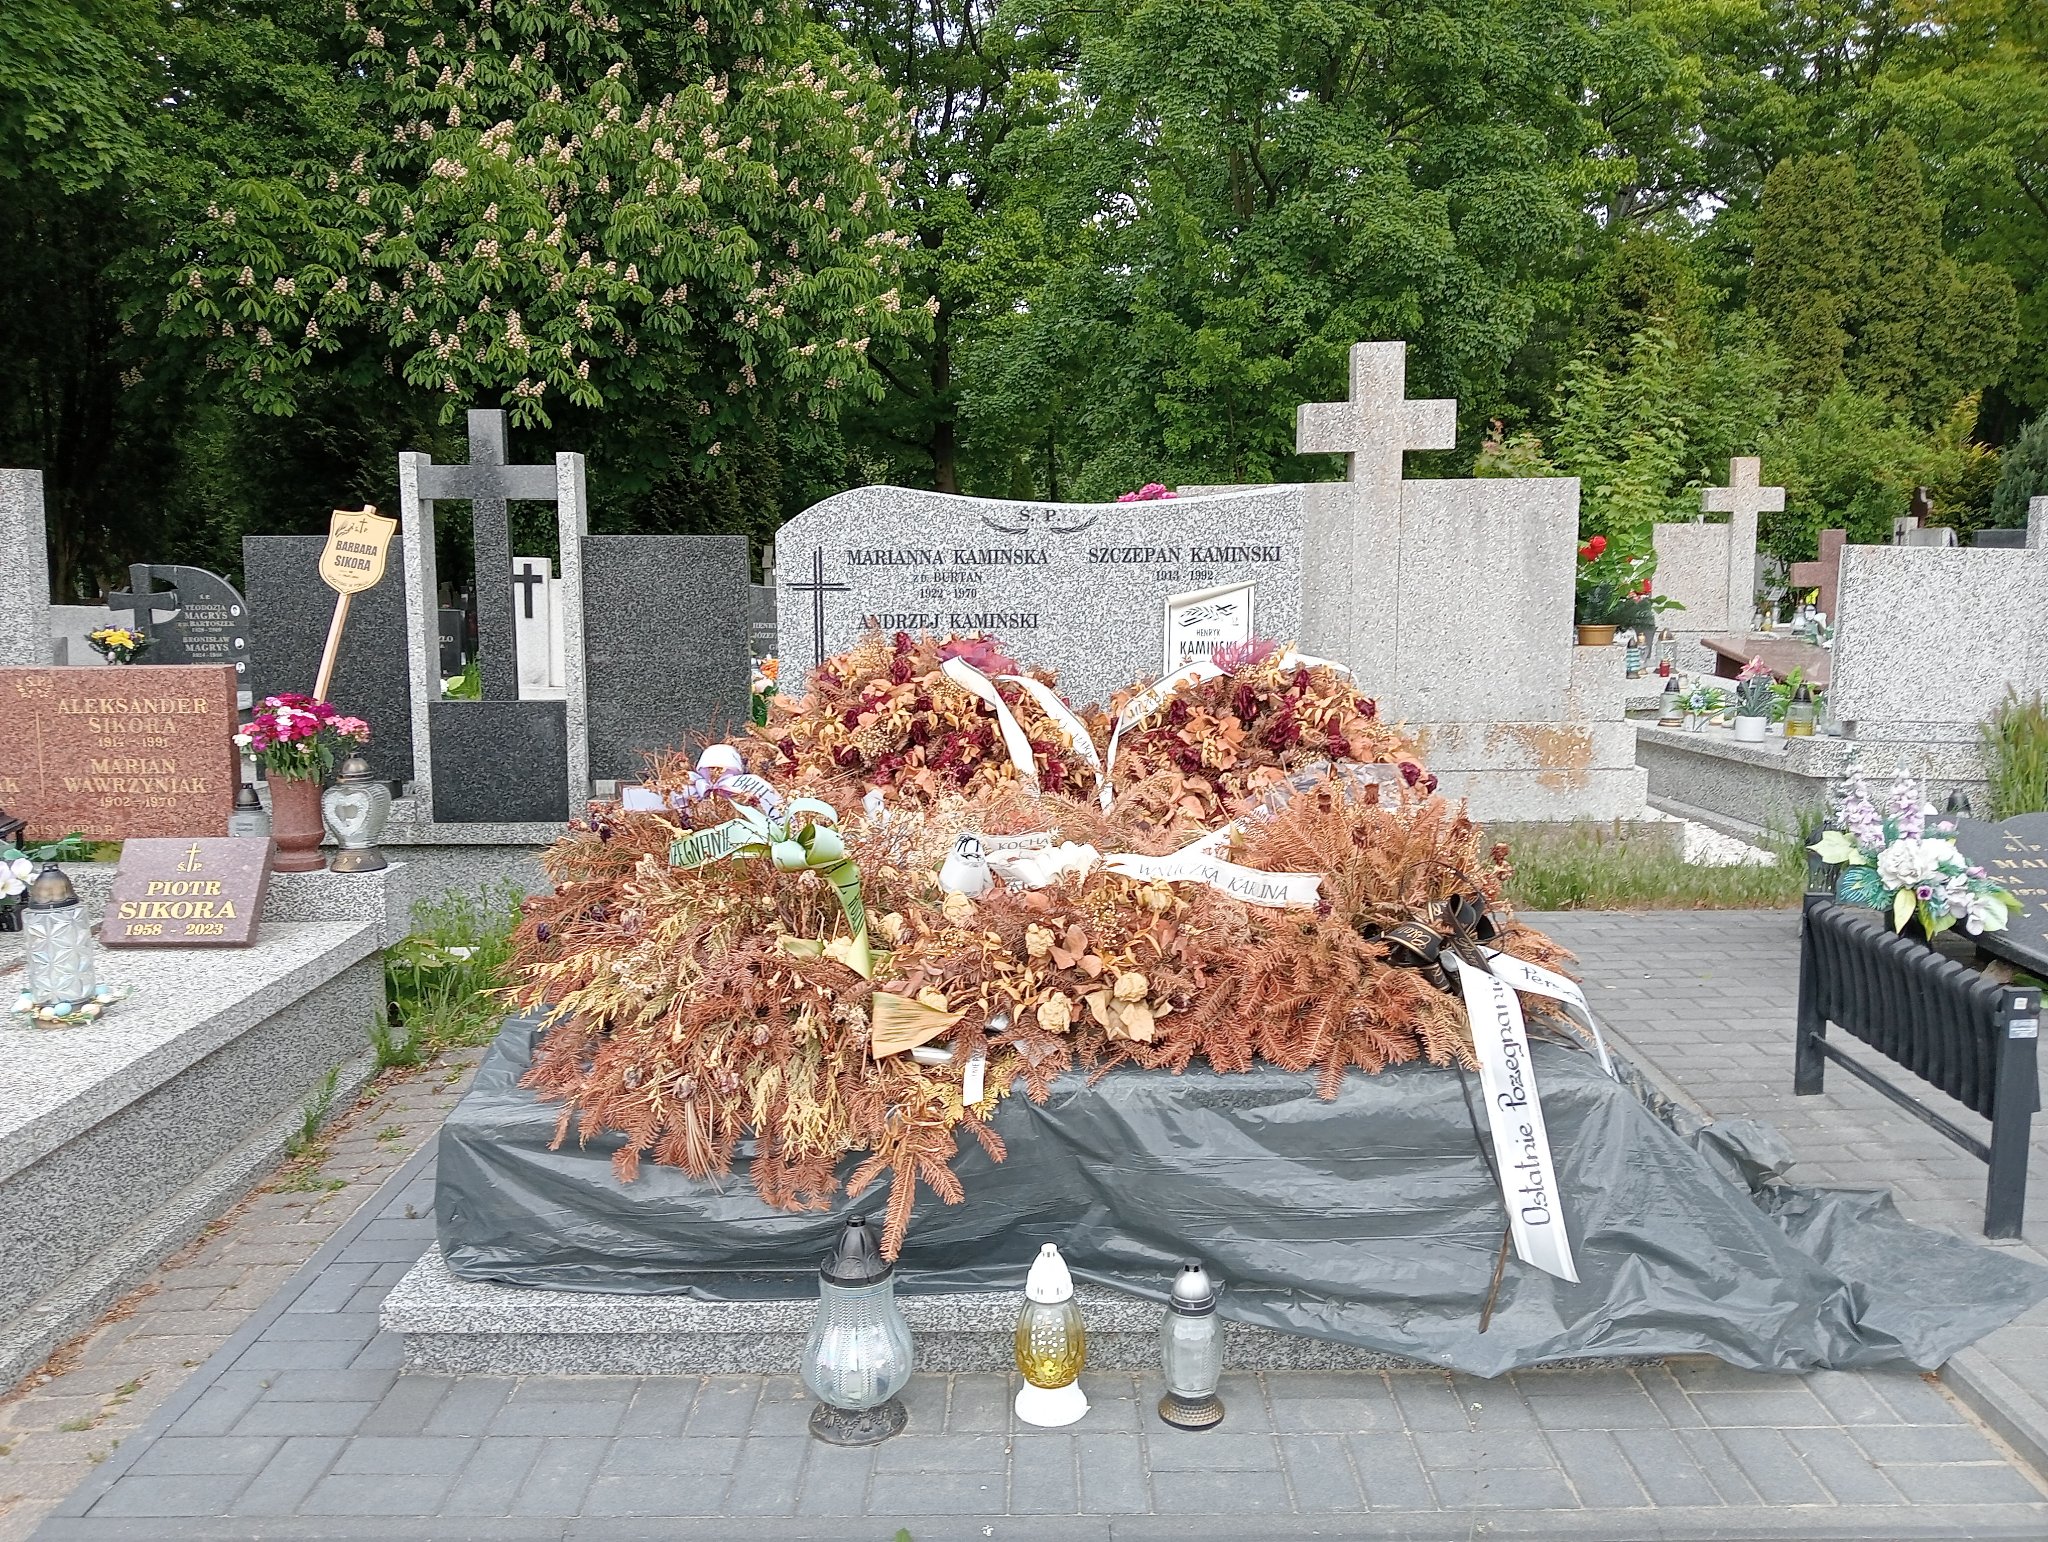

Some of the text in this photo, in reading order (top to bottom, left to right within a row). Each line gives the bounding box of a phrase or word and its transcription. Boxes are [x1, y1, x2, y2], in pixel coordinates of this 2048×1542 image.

[335, 541, 378, 557] BARBARA
[847, 549, 945, 566] MARIANNA
[1089, 547, 1181, 564] SZCZEPAN
[334, 555, 371, 572] SIKORA
[1189, 570, 1214, 581] 1992
[920, 588, 944, 599] 1922
[954, 588, 977, 599] 1970
[858, 614, 941, 629] ANDRZEJ
[1196, 628, 1221, 637] HENRYK
[58, 698, 209, 715] ALEKSANDER
[88, 717, 178, 734] SIKORA
[90, 757, 176, 775] MARIAN
[62, 776, 209, 794] WAWRZYNIAK
[145, 881, 222, 896] PIOTR
[118, 900, 237, 920] SIKORA
[124, 923, 162, 936] 1958
[183, 923, 224, 936] 2023
[1514, 1122, 1551, 1226] Ostatnie
